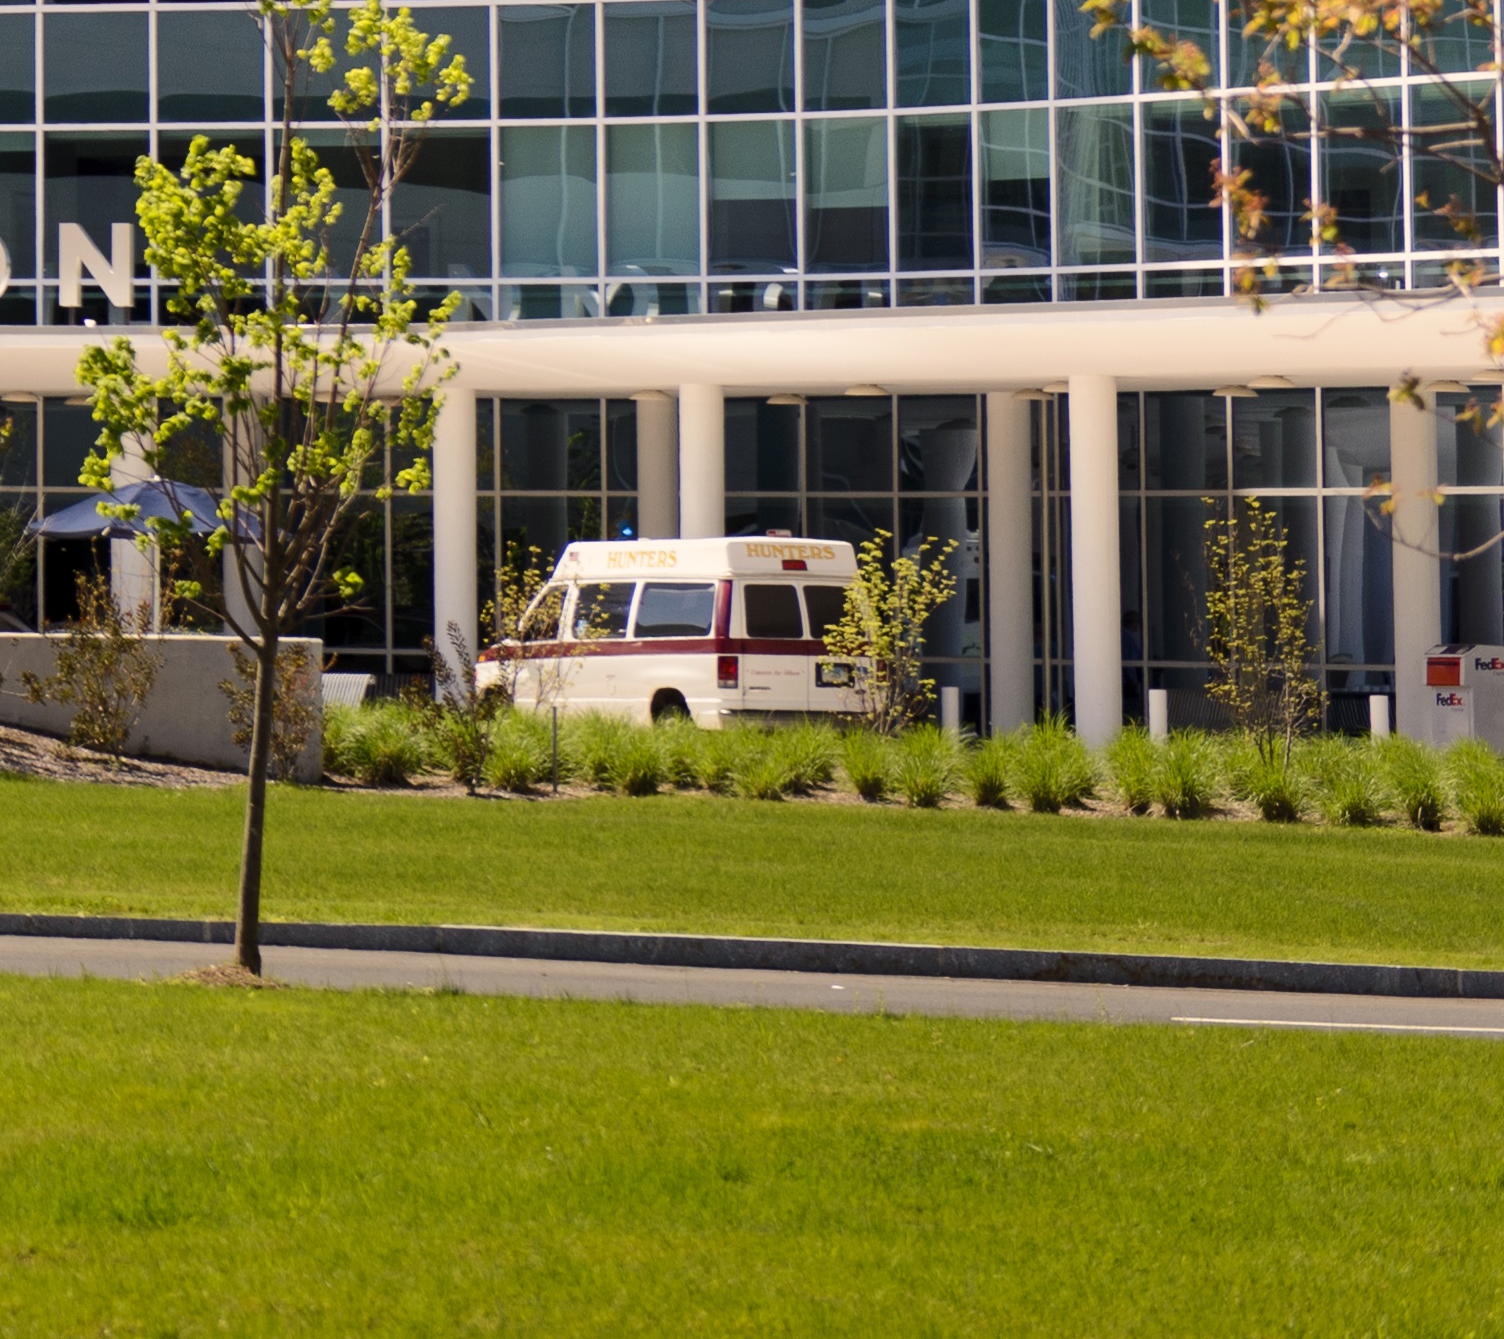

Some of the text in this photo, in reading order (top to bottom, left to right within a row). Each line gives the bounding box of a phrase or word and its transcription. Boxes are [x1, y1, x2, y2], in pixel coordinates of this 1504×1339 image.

[607, 550, 678, 569] HUNTERS
[746, 543, 836, 560] HUNTERS
[1436, 693, 1463, 706] FedEx
